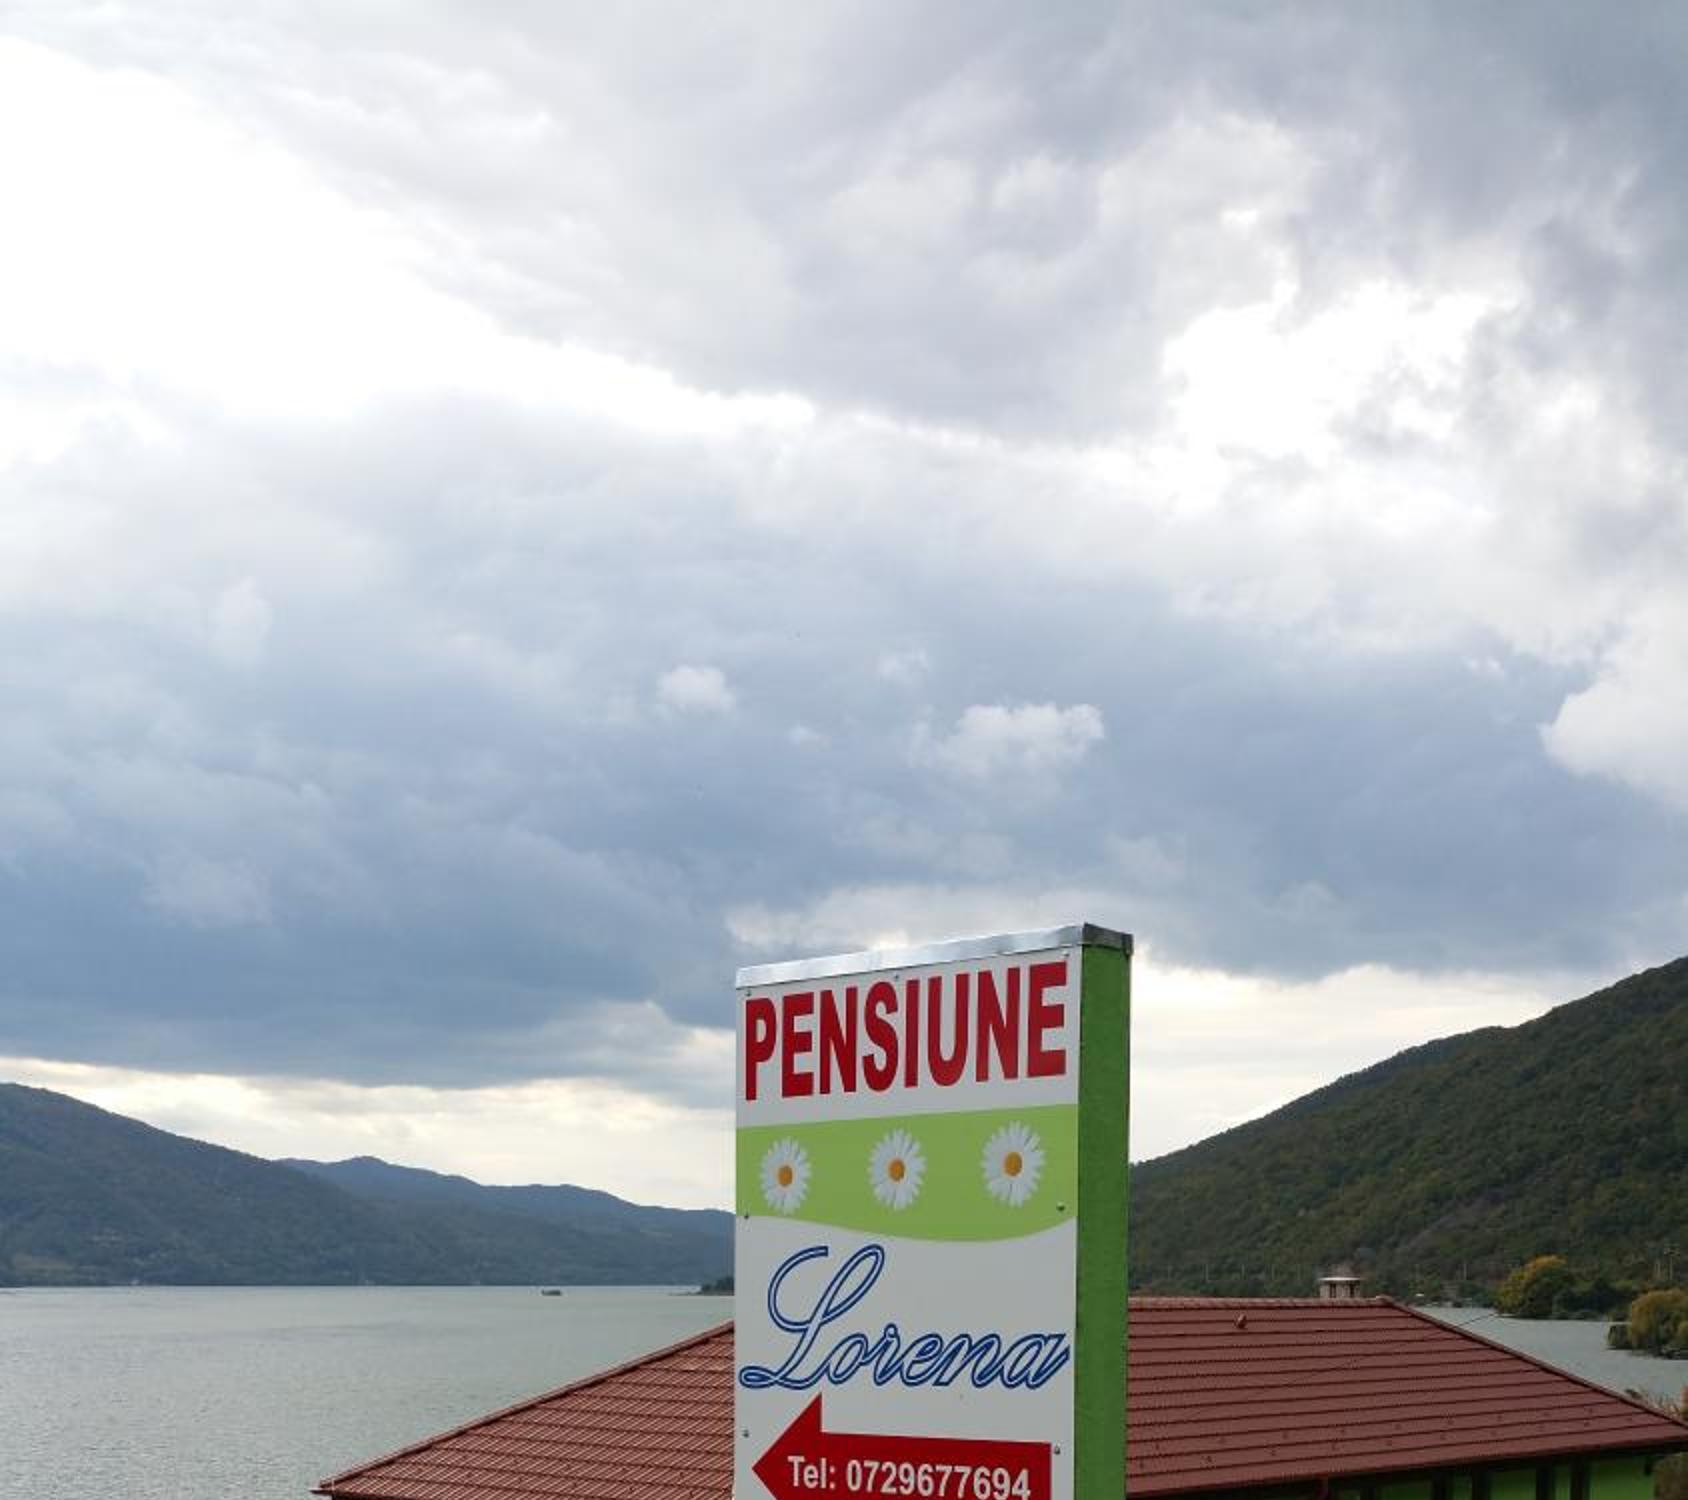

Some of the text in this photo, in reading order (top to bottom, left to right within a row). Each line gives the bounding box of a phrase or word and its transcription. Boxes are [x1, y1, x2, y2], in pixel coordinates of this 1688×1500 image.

[745, 961, 1068, 1101] PENSIUNE
[739, 1244, 1070, 1390] Lorena
[787, 1455, 836, 1490] Tel:
